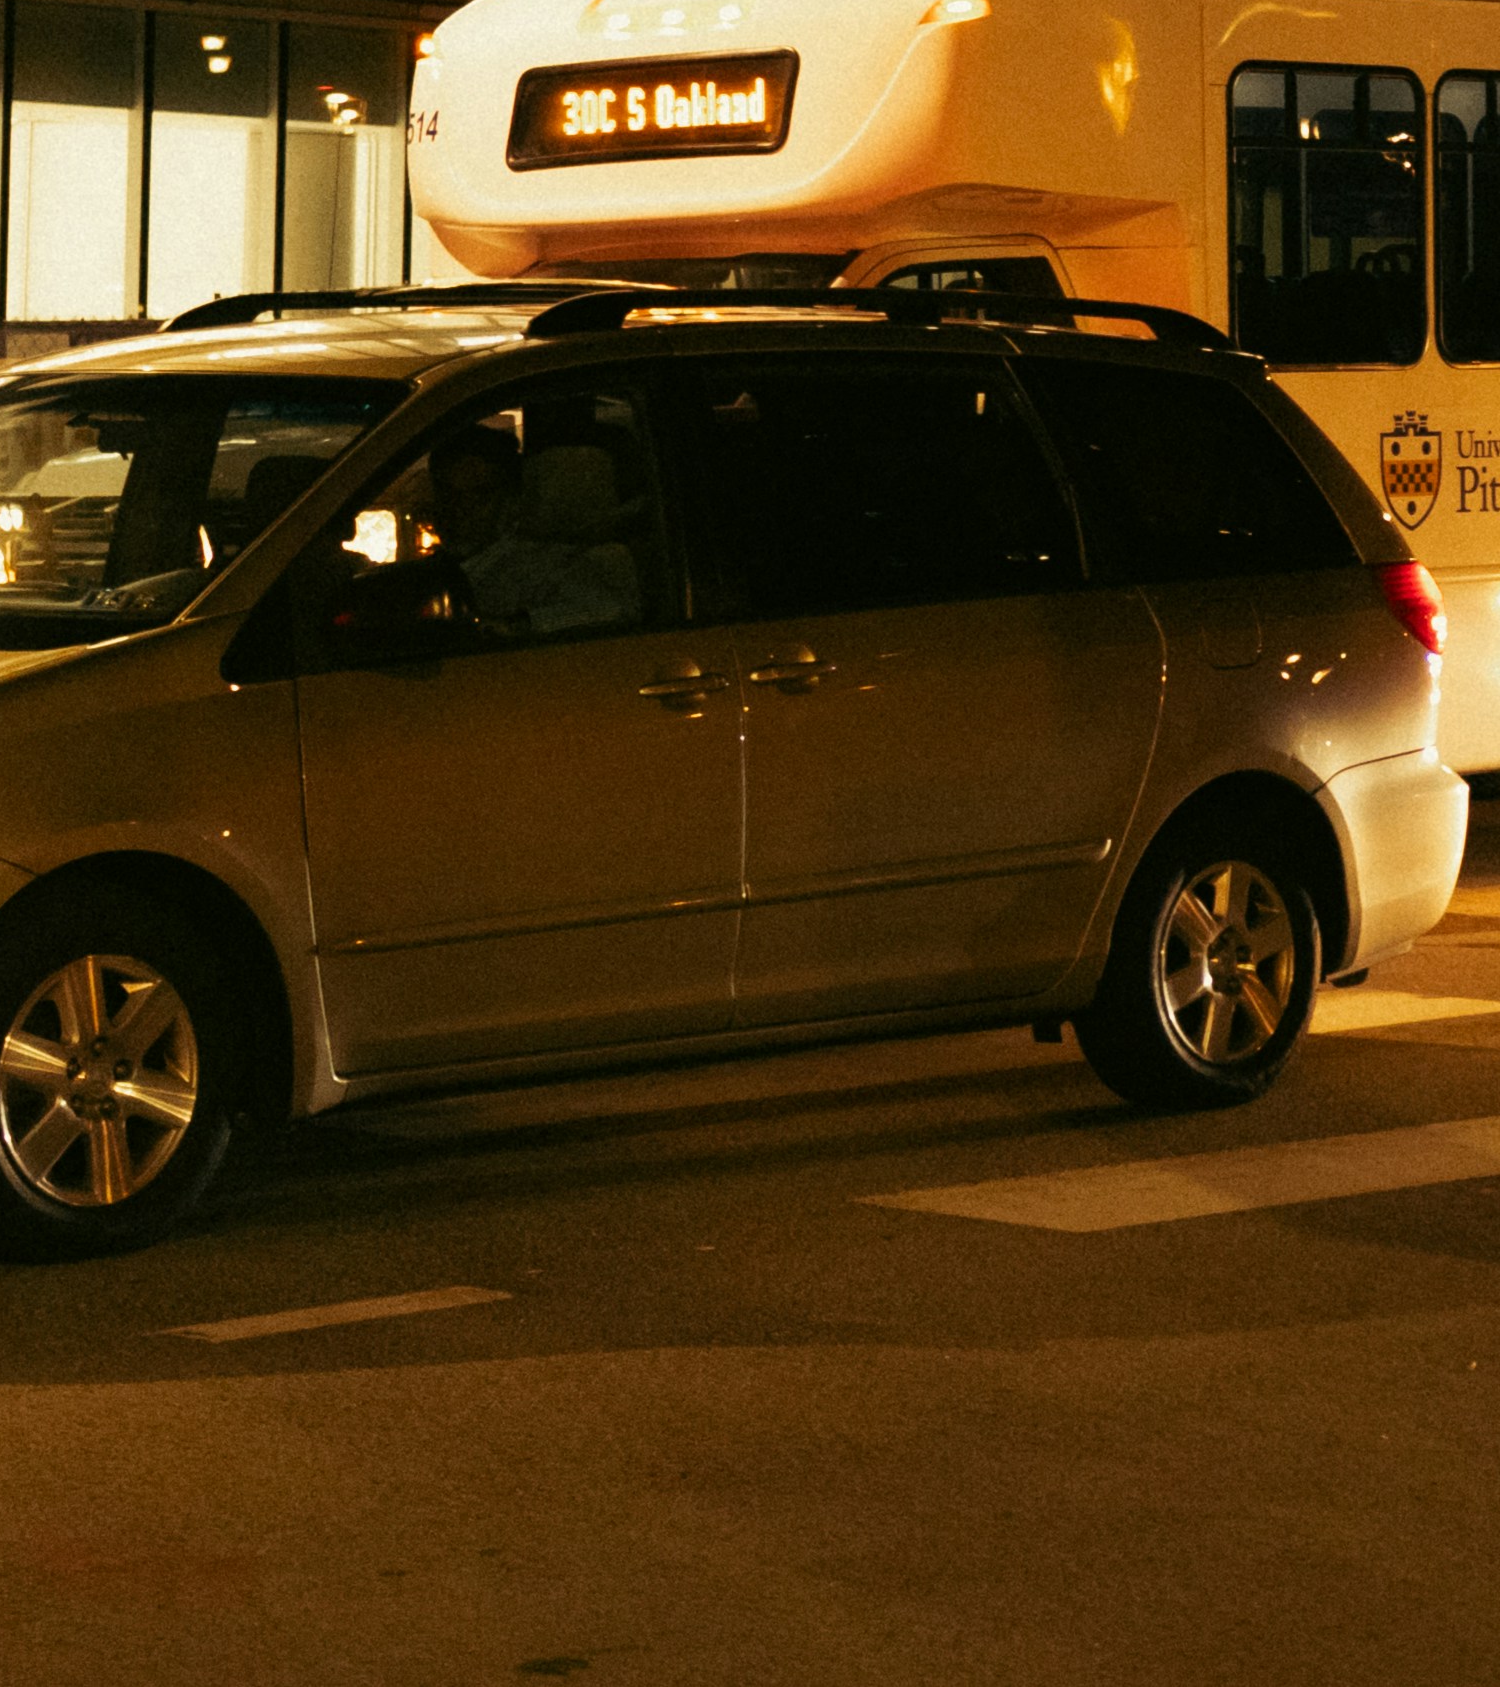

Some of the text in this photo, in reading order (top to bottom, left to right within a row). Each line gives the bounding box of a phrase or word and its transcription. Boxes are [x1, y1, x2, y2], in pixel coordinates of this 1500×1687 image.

[562, 77, 766, 136] 30C S Oakland
